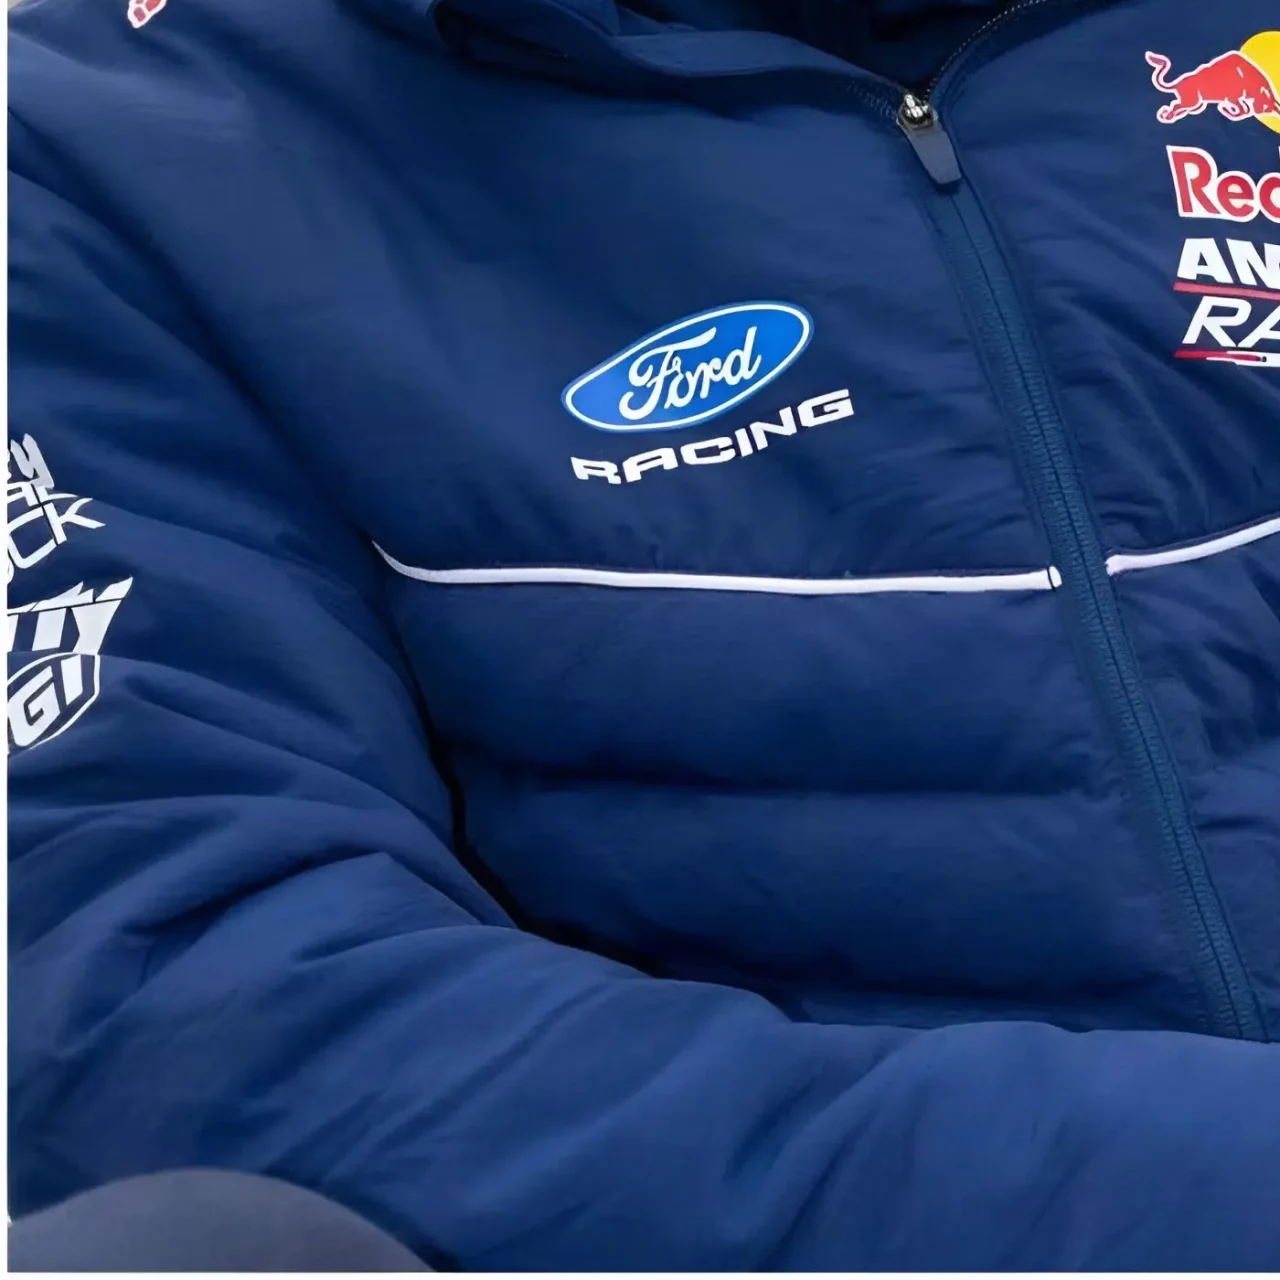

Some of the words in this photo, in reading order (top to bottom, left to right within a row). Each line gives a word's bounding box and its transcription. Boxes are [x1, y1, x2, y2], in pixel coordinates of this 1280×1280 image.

[618, 325, 762, 421] Ford
[570, 388, 855, 485] RACING
[8, 654, 83, 747] GI
